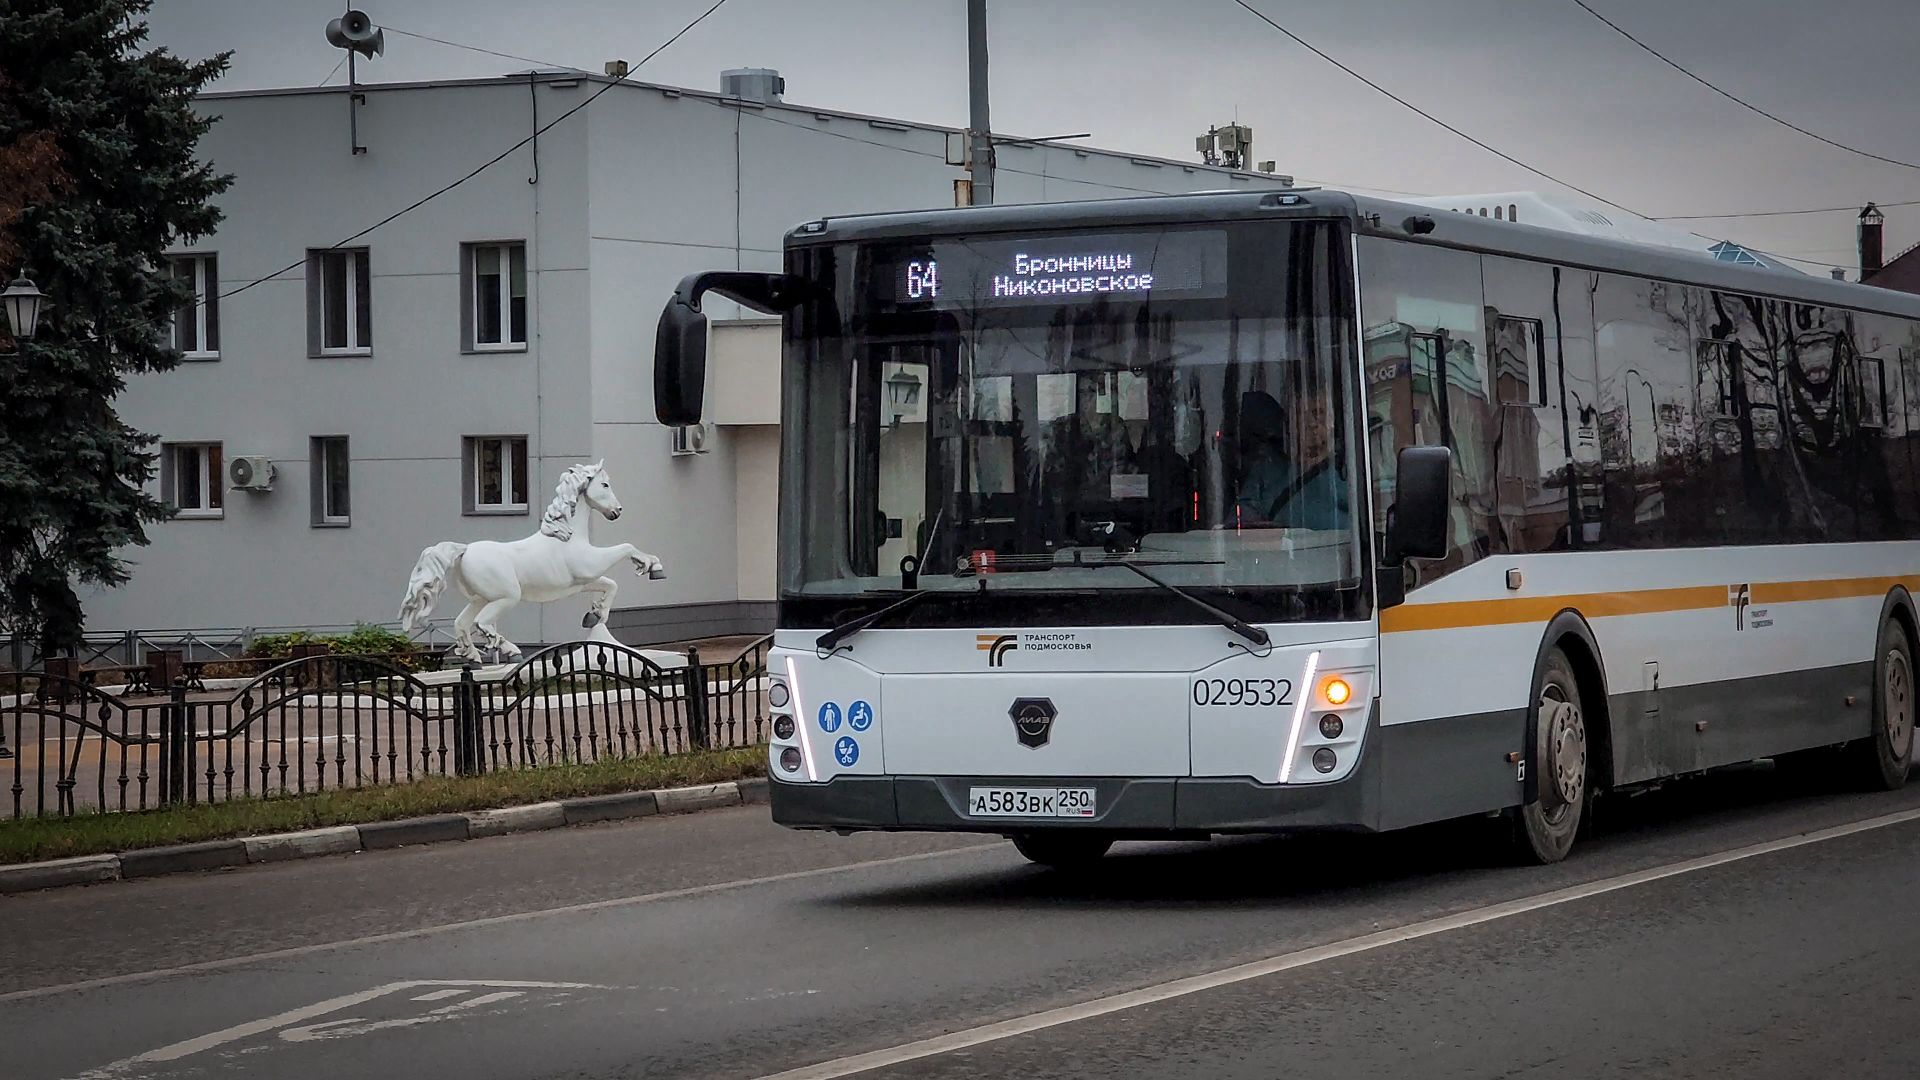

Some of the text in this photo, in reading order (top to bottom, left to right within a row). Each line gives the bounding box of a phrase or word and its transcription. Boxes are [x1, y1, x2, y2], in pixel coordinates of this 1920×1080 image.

[1015, 253, 1132, 276] Бронницы
[907, 261, 937, 298] 64
[994, 274, 1153, 297] Никоновское
[1024, 643, 1092, 651] ПОДМОСКОВЬЯ
[1193, 679, 1293, 706] 029532
[976, 791, 1089, 813] А583ВК 250
